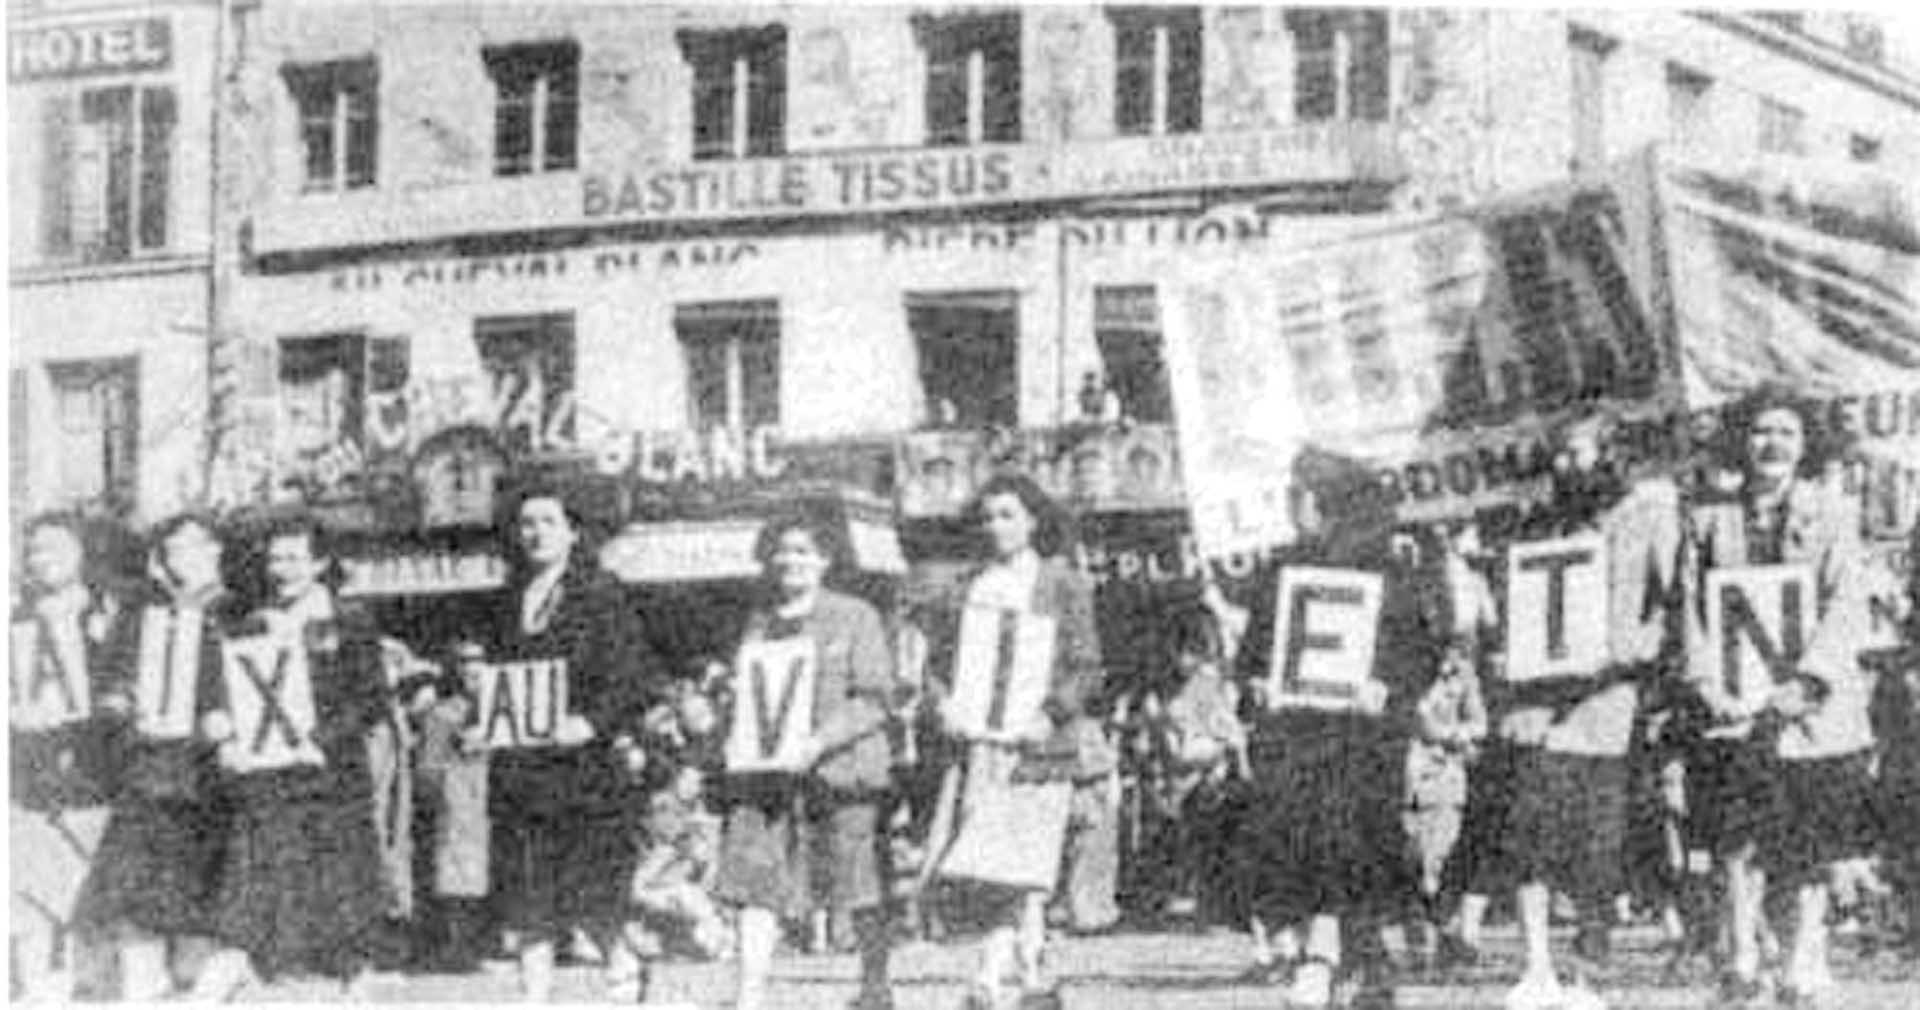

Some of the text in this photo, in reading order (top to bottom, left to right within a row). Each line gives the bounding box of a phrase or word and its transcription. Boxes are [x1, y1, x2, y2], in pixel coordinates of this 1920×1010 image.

[11, 23, 160, 75] HOTEL
[583, 166, 803, 217] BASTILLE
[832, 151, 1012, 203] TISSUS
[597, 422, 786, 485] BLANC
[1295, 586, 1366, 698] E
[1519, 550, 1593, 660] T
[1720, 580, 1802, 698] N
[30, 608, 79, 715] A
[236, 648, 300, 752] X
[485, 667, 558, 746] AU
[751, 657, 806, 760] V
[985, 608, 1016, 732] I
